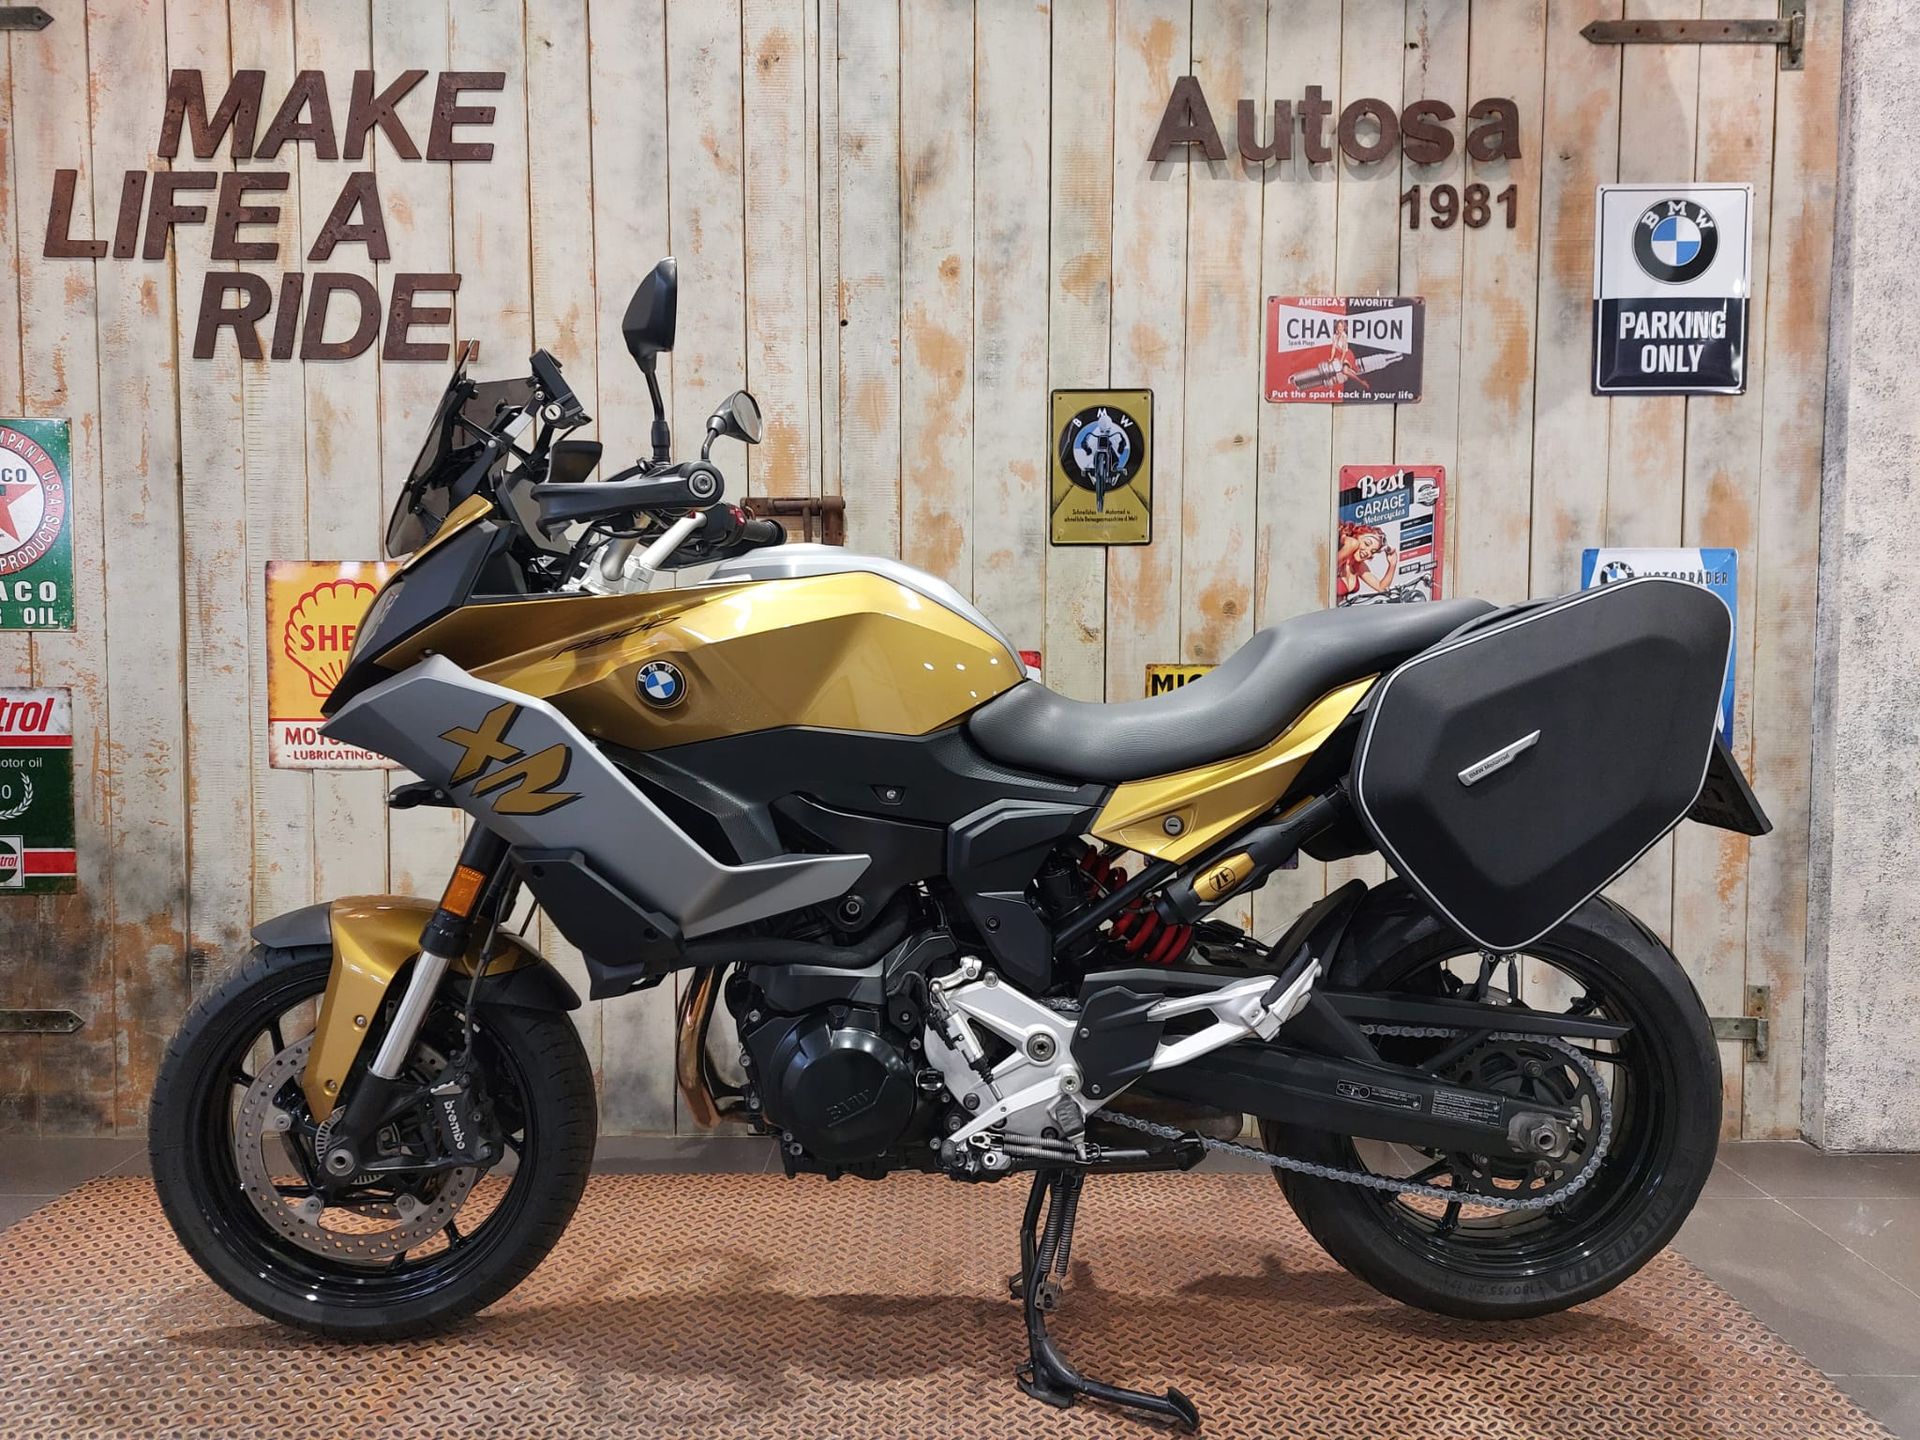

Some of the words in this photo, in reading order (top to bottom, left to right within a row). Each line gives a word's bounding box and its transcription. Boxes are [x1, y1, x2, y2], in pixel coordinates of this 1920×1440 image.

[157, 69, 506, 161] MAKE
[1147, 75, 1522, 164] Autosa
[43, 169, 290, 260] LIFE
[307, 171, 390, 261] A
[1400, 184, 1518, 229] 1981
[1641, 200, 1714, 230] BMW
[1298, 297, 1345, 307] AMERICA'S
[1349, 298, 1394, 307] FAVORITE
[1619, 311, 1726, 340] PARKING
[1641, 344, 1704, 374] ONLY
[1272, 390, 1288, 398] Put
[1291, 390, 1306, 398] the
[1309, 390, 1335, 400] spark
[1337, 390, 1360, 399] back
[1363, 390, 1371, 399] in
[1374, 392, 1396, 401] your
[1398, 391, 1414, 399] life
[1357, 469, 1405, 499] Best
[1355, 493, 1405, 519] GARAGE
[24, 607, 59, 624] OIL
[639, 663, 674, 682] BMW
[29, 757, 42, 768] oil
[294, 750, 373, 760] LUBRICATING
[1213, 871, 1232, 890] ZF
[444, 1100, 466, 1150] brembo
